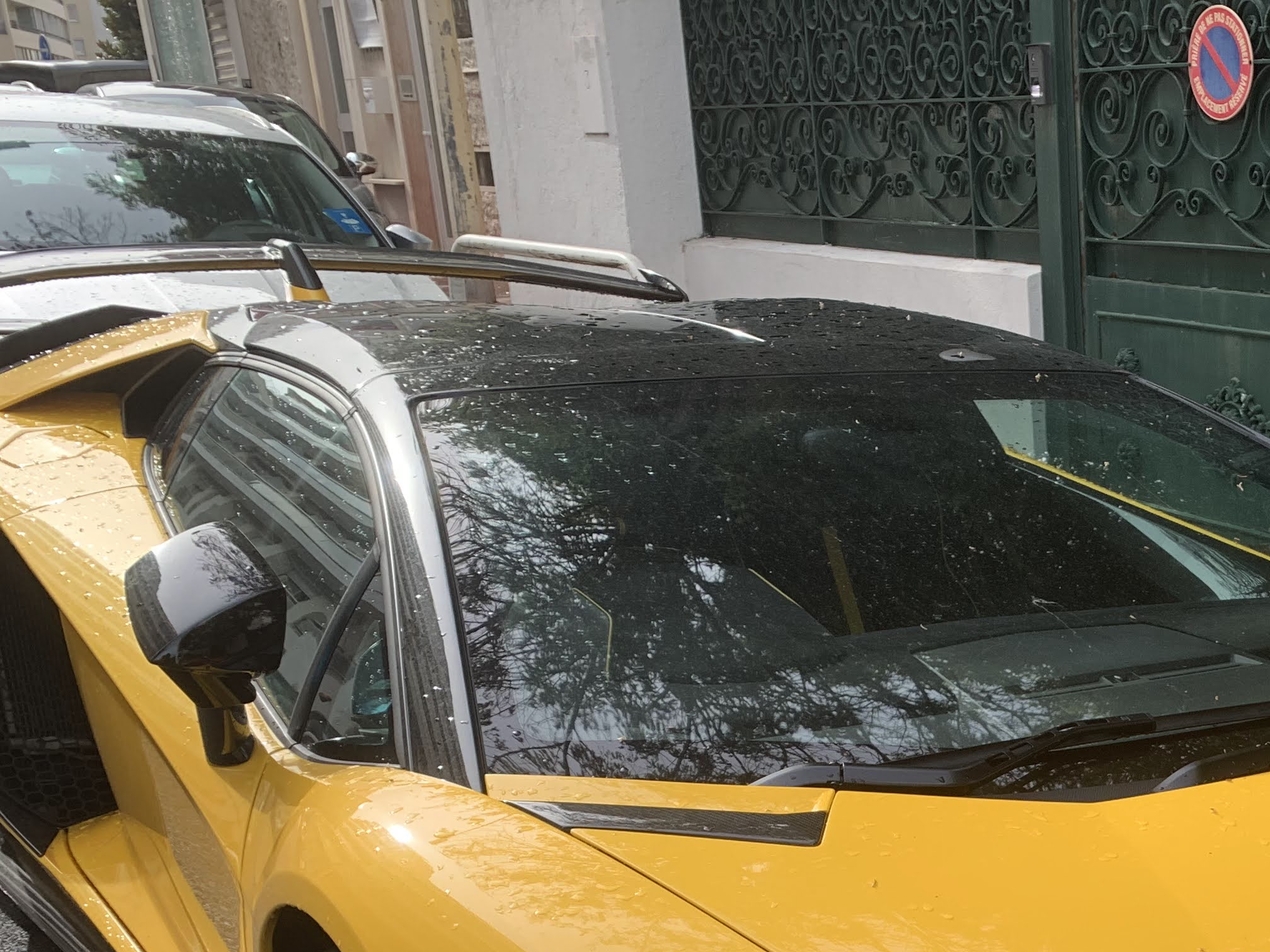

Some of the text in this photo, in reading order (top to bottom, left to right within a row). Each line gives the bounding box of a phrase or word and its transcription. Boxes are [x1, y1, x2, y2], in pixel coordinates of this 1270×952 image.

[1198, 20, 1207, 35] DE
[1205, 13, 1214, 27] NE
[1214, 12, 1225, 23] PAS
[1225, 15, 1249, 65] STATIONNER
[1193, 76, 1229, 114] EMPLACEMENT
